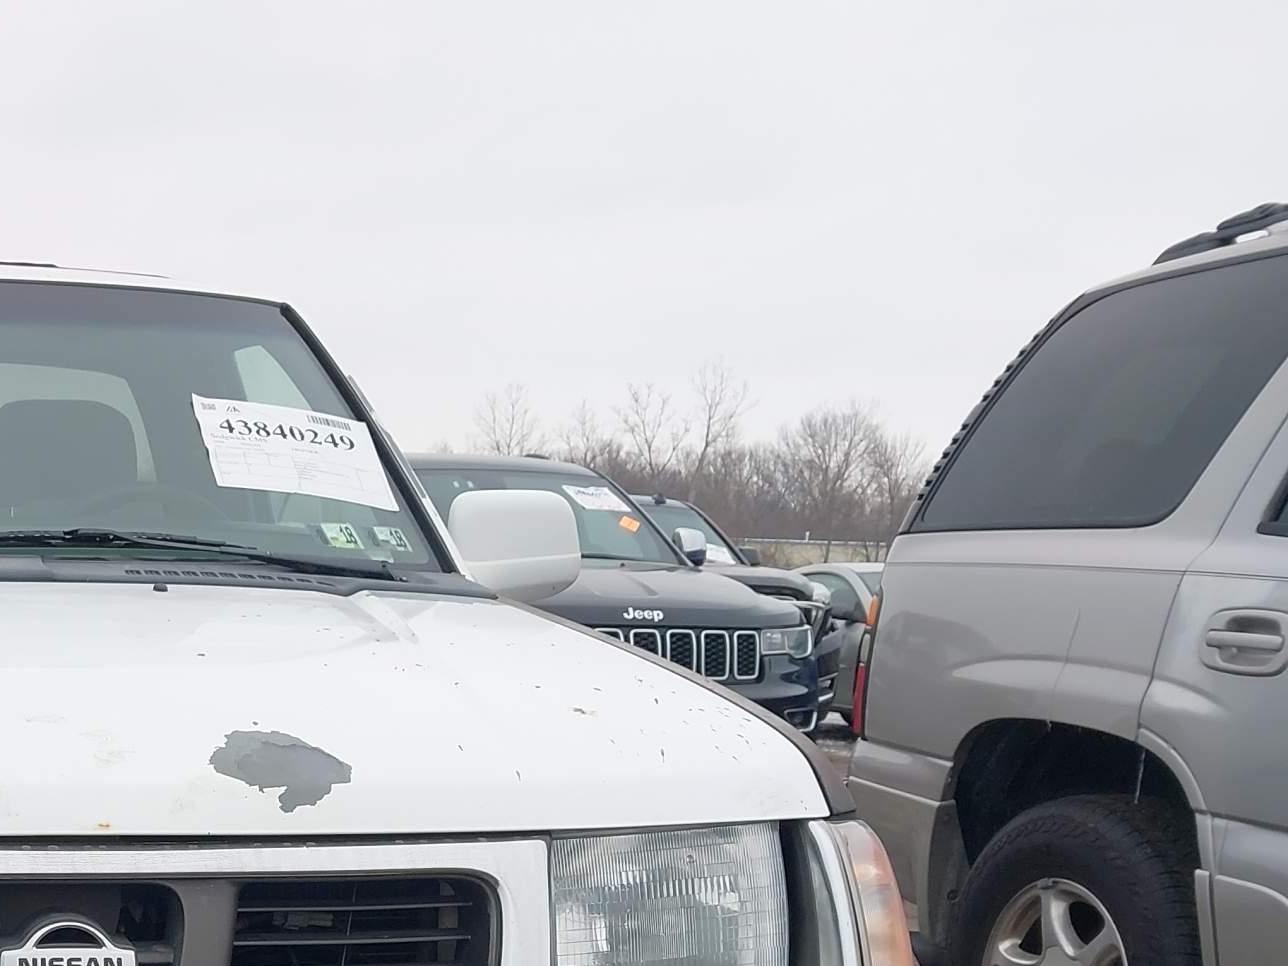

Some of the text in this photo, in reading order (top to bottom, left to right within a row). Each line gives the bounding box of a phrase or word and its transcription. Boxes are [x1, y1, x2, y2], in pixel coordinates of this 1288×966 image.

[219, 418, 355, 451] 43840249
[339, 525, 359, 545] 18
[389, 528, 408, 548] 18
[623, 607, 664, 622] Jeep
